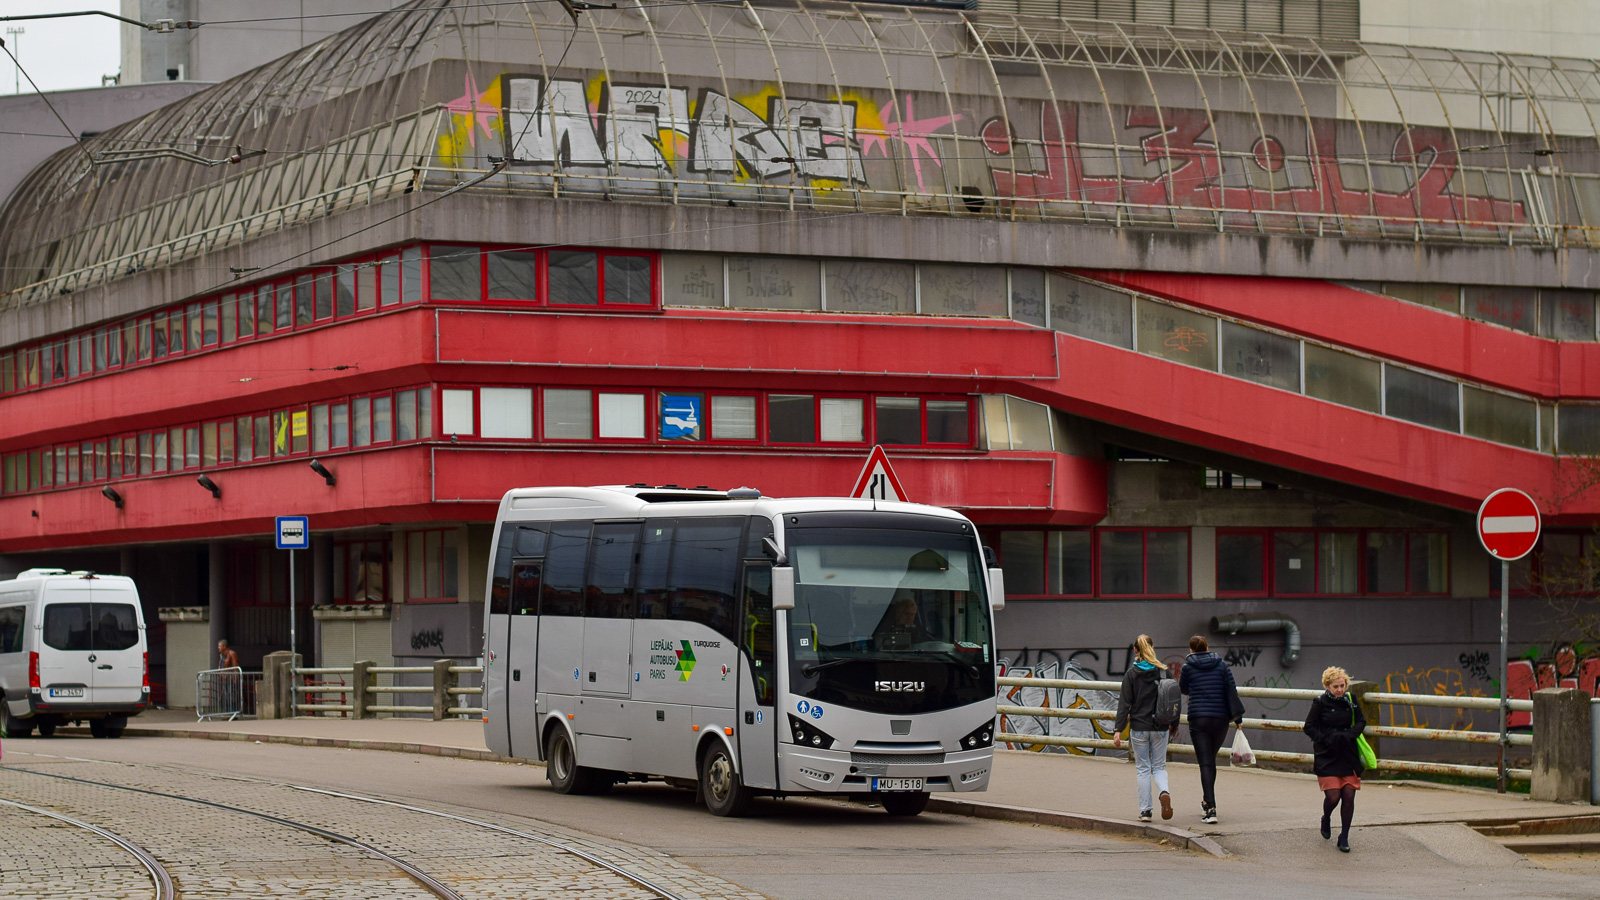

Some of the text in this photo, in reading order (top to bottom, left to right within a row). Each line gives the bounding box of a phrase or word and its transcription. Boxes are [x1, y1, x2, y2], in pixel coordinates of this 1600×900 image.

[626, 90, 666, 106] 2024
[650, 639, 673, 651] LIEPĀJAS
[694, 640, 721, 649] TURQUOISE
[650, 655, 677, 666] AUTOBUSU
[650, 668, 666, 680] PARKS
[874, 681, 926, 692] ISUZU
[879, 779, 922, 789] MU-1518
